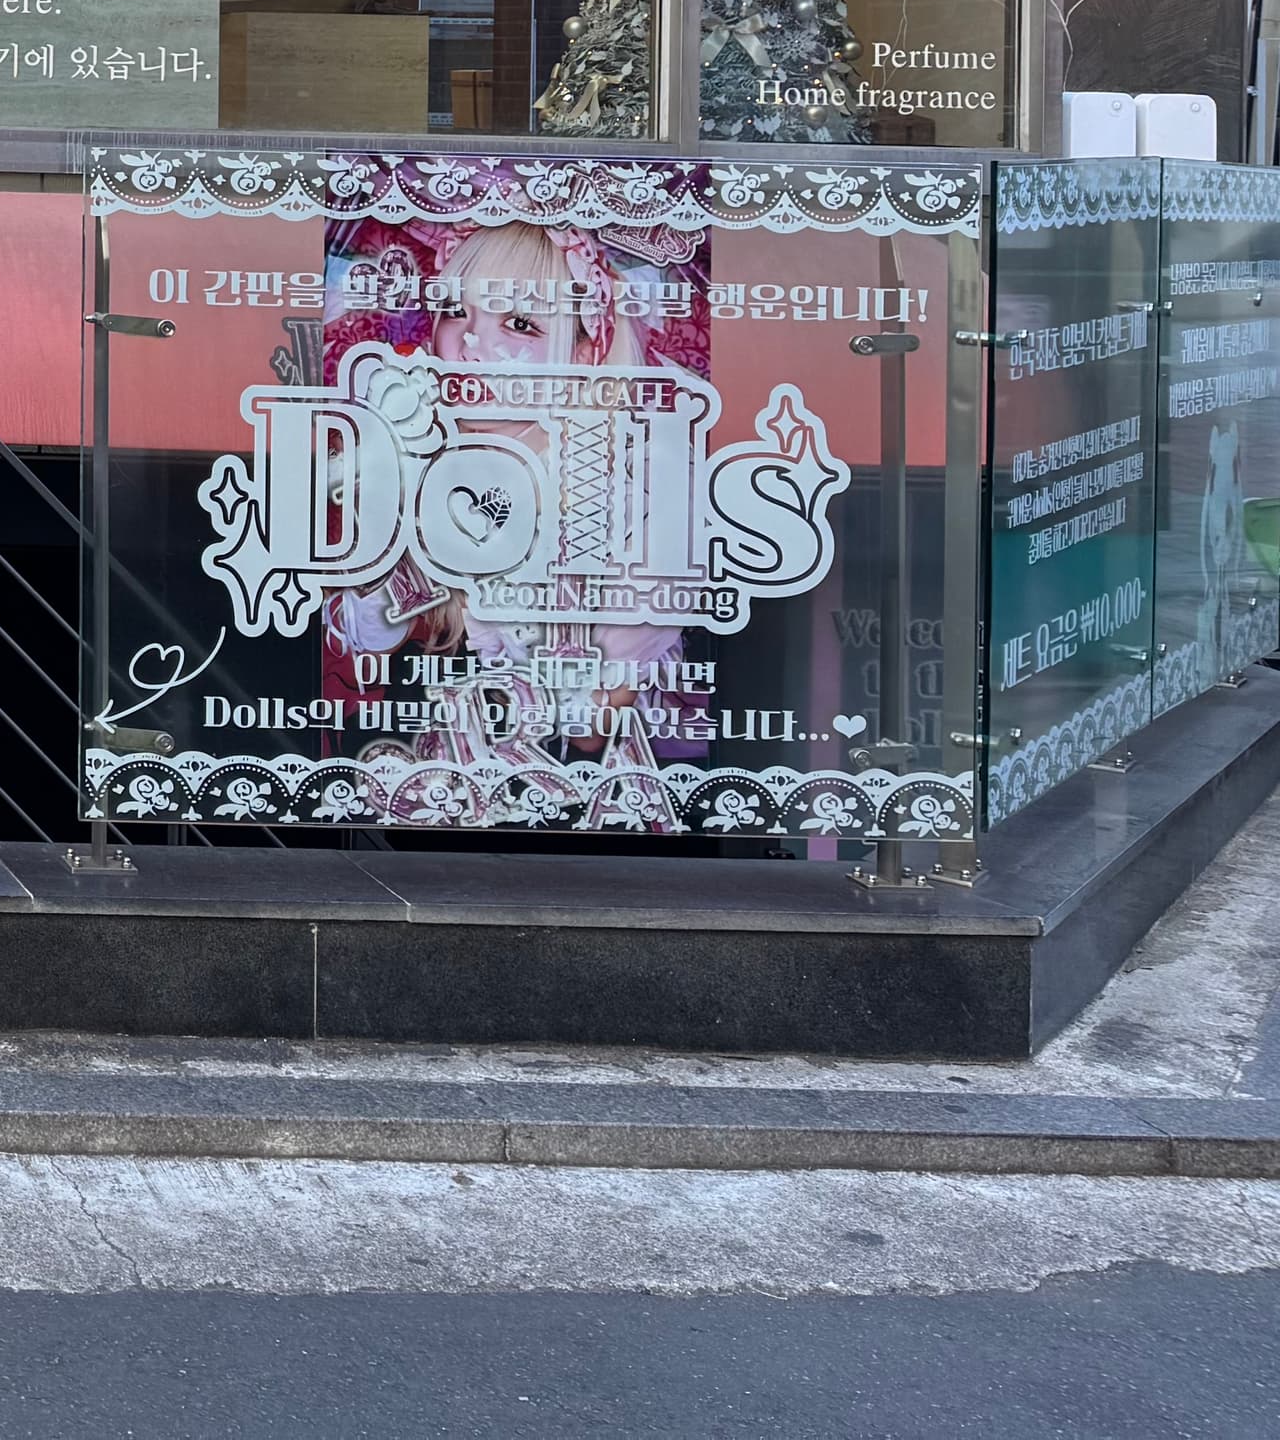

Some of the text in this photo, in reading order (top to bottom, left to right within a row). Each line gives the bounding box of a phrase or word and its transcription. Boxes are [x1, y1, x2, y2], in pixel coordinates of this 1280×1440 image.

[69, 44, 213, 83] 있습니다.
[871, 42, 997, 70] Perfume
[755, 80, 997, 116] Home fragrance
[148, 267, 929, 324] 이 간판을 발견한 당신은 정말 행운입니다!
[1008, 334, 1035, 381] 한국
[1036, 328, 1060, 371] 최초
[1062, 318, 1096, 368] 일본식
[439, 374, 674, 410] CONCEPT CAFE
[248, 393, 830, 591] Dolls
[481, 580, 739, 619] YeonNam-dong
[1000, 631, 1033, 693] 세트
[1035, 608, 1079, 674] 요금은
[354, 653, 718, 695] 이 계단을 내려가시면
[202, 695, 346, 732] Dolls의
[358, 700, 471, 735] 비밀의
[481, 702, 637, 740] 인형방이
[642, 705, 831, 742] 있습니다...
